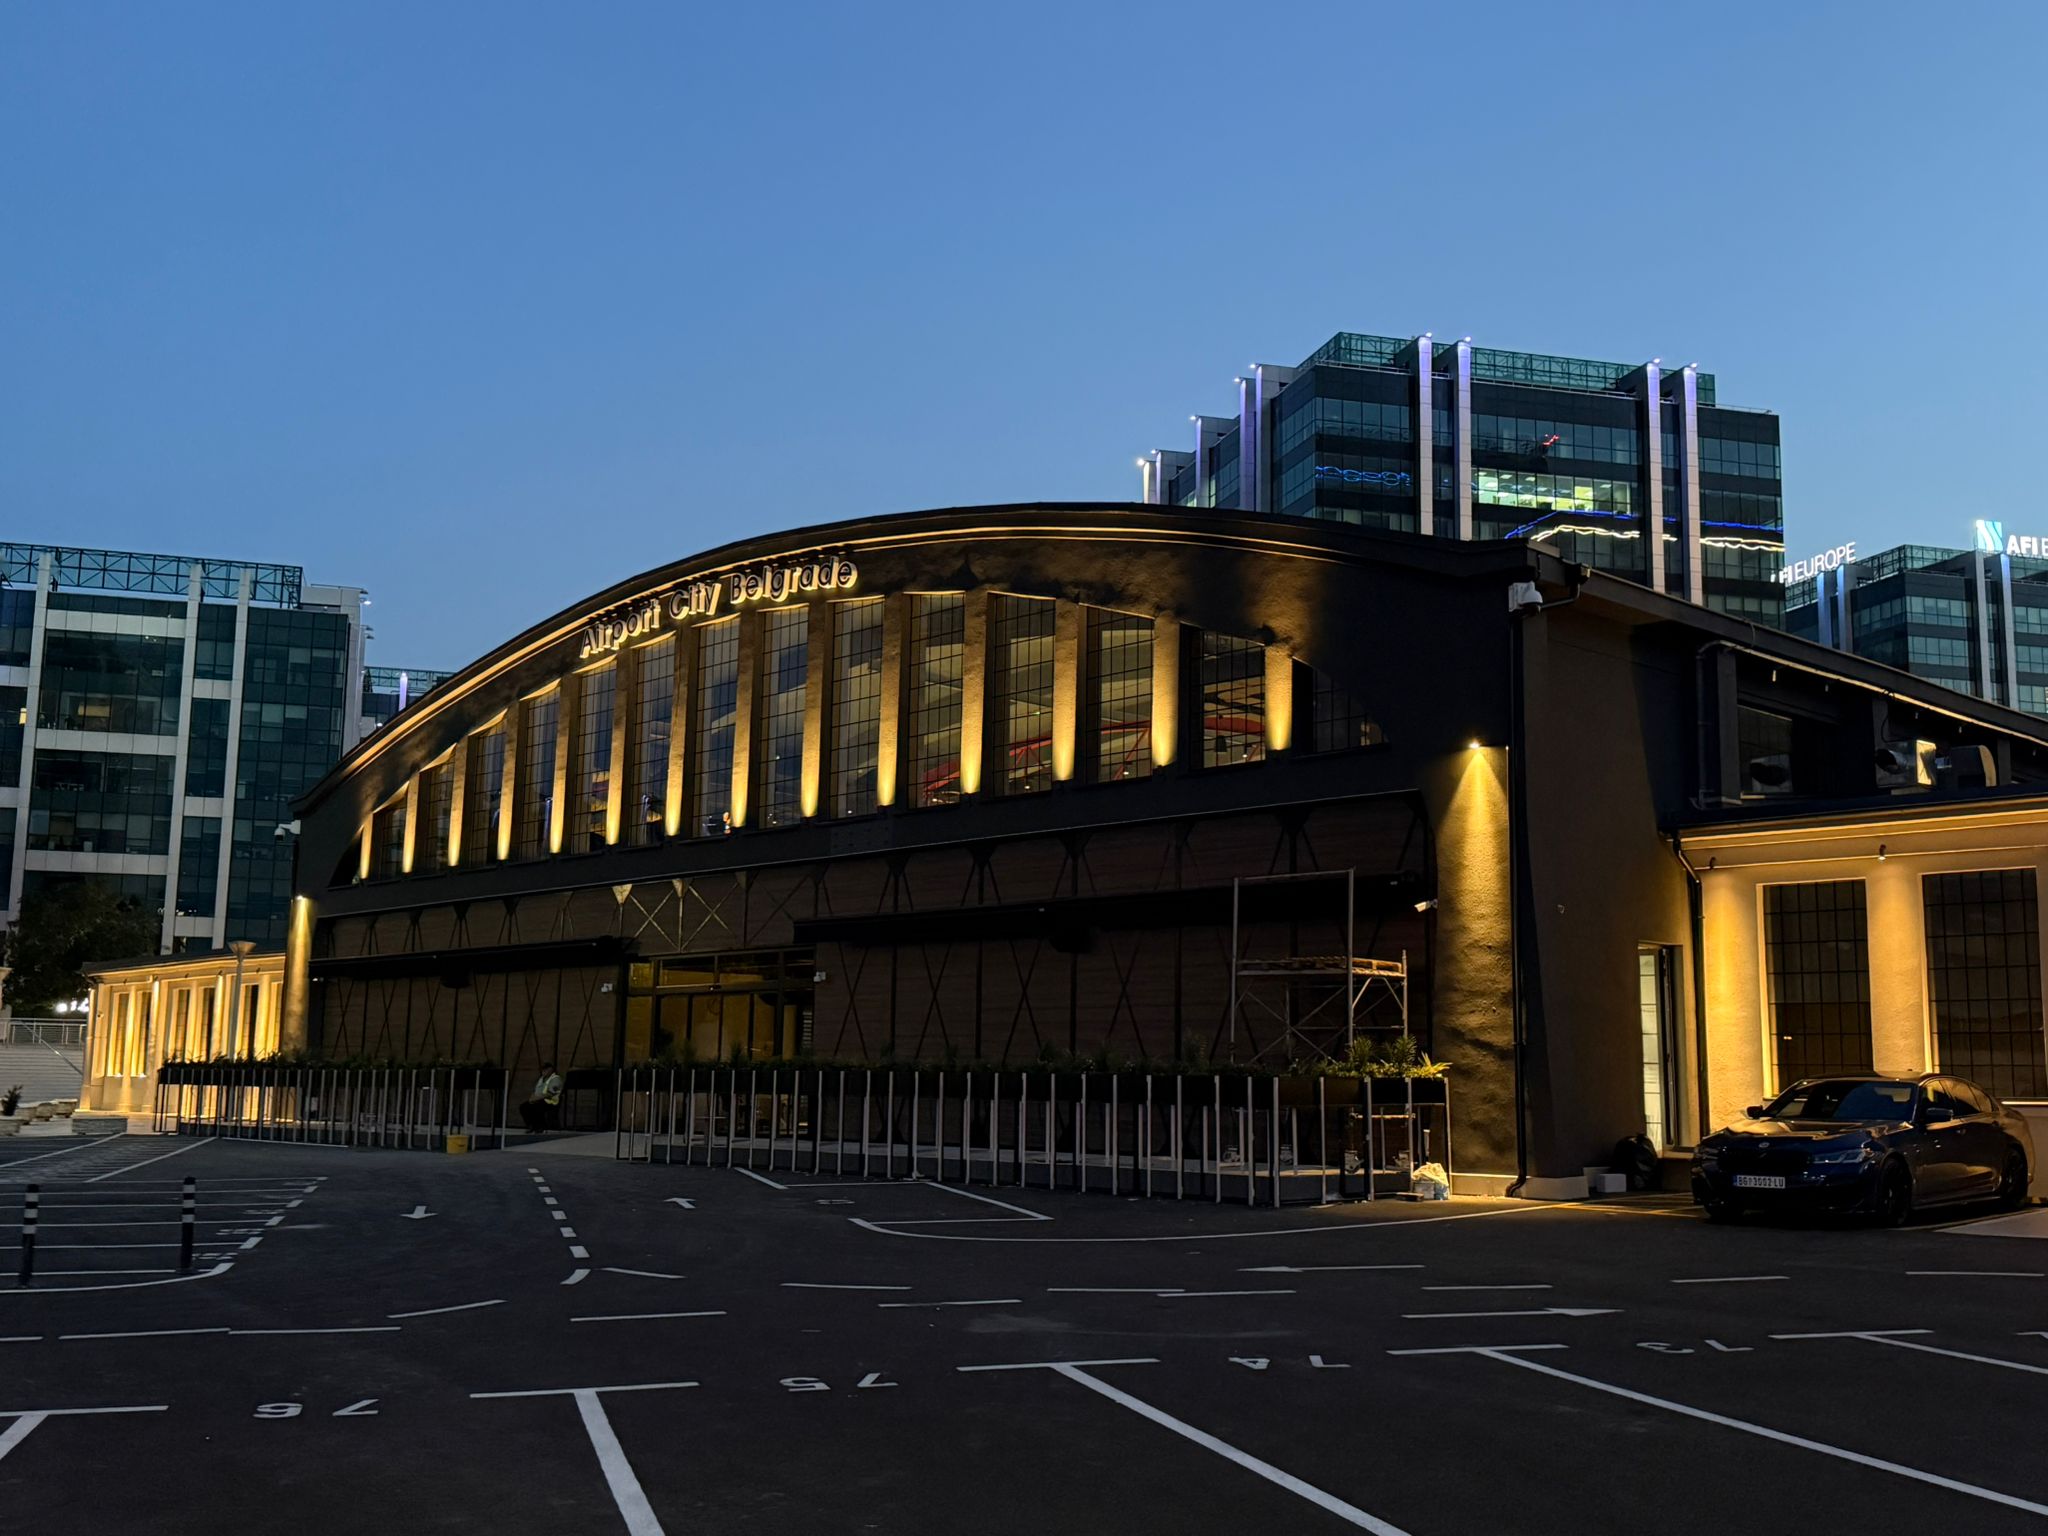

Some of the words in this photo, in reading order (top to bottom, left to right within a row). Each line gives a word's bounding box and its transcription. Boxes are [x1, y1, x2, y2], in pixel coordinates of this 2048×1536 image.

[1794, 541, 1856, 582] EUROPE
[2006, 534, 2038, 555] AFI
[579, 598, 661, 659] Airport
[669, 582, 722, 620] City
[730, 555, 858, 604] Belgrade
